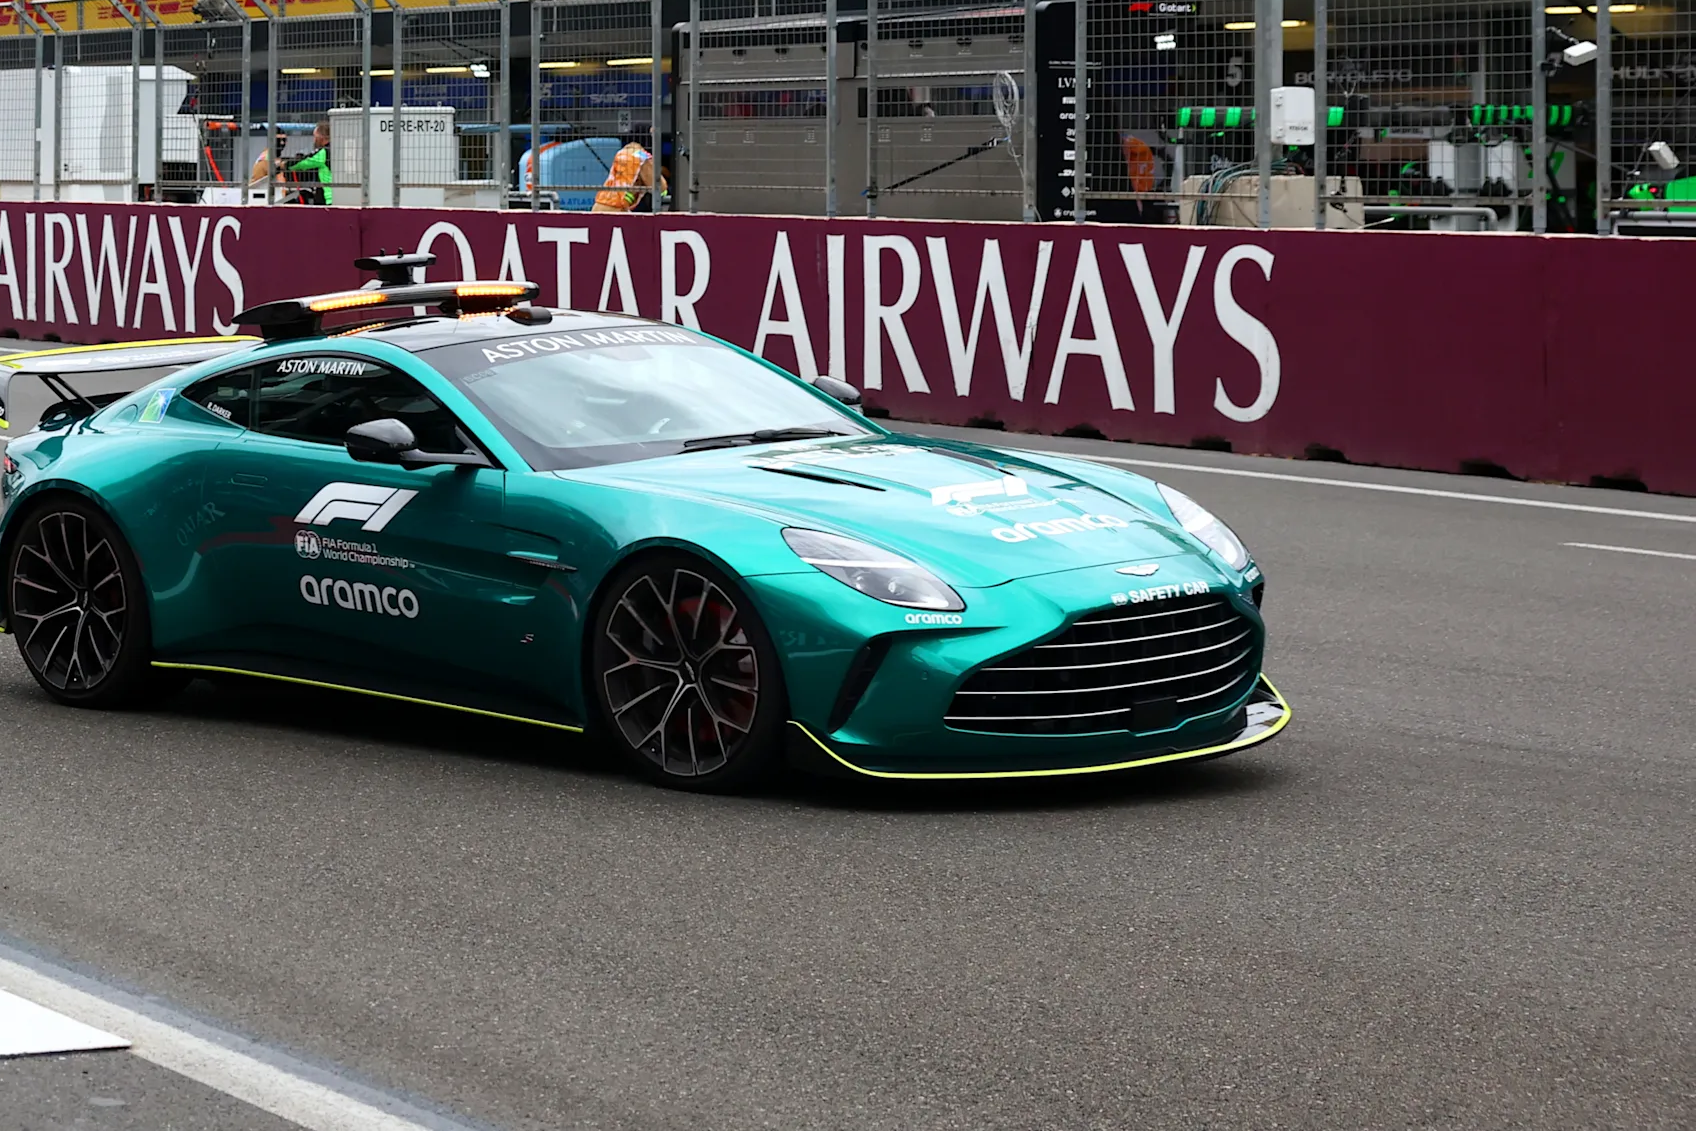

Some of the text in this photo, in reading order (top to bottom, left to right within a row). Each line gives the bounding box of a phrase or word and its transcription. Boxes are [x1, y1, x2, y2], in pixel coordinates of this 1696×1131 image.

[1058, 77, 1091, 88] LV
[380, 120, 445, 132] DERE-RT-20
[752, 231, 1281, 422] AIRWAYS
[481, 329, 697, 363] ASTON MARTIN
[277, 360, 367, 376] ASTON MARTIN
[991, 512, 1128, 543] aramco
[296, 534, 377, 554] FIA FIA Formula 1
[323, 549, 409, 569] World Championship
[300, 574, 420, 618] aramco
[1129, 584, 1180, 604] SAFETY
[1183, 581, 1210, 596] CAR
[905, 612, 962, 625] aramco
